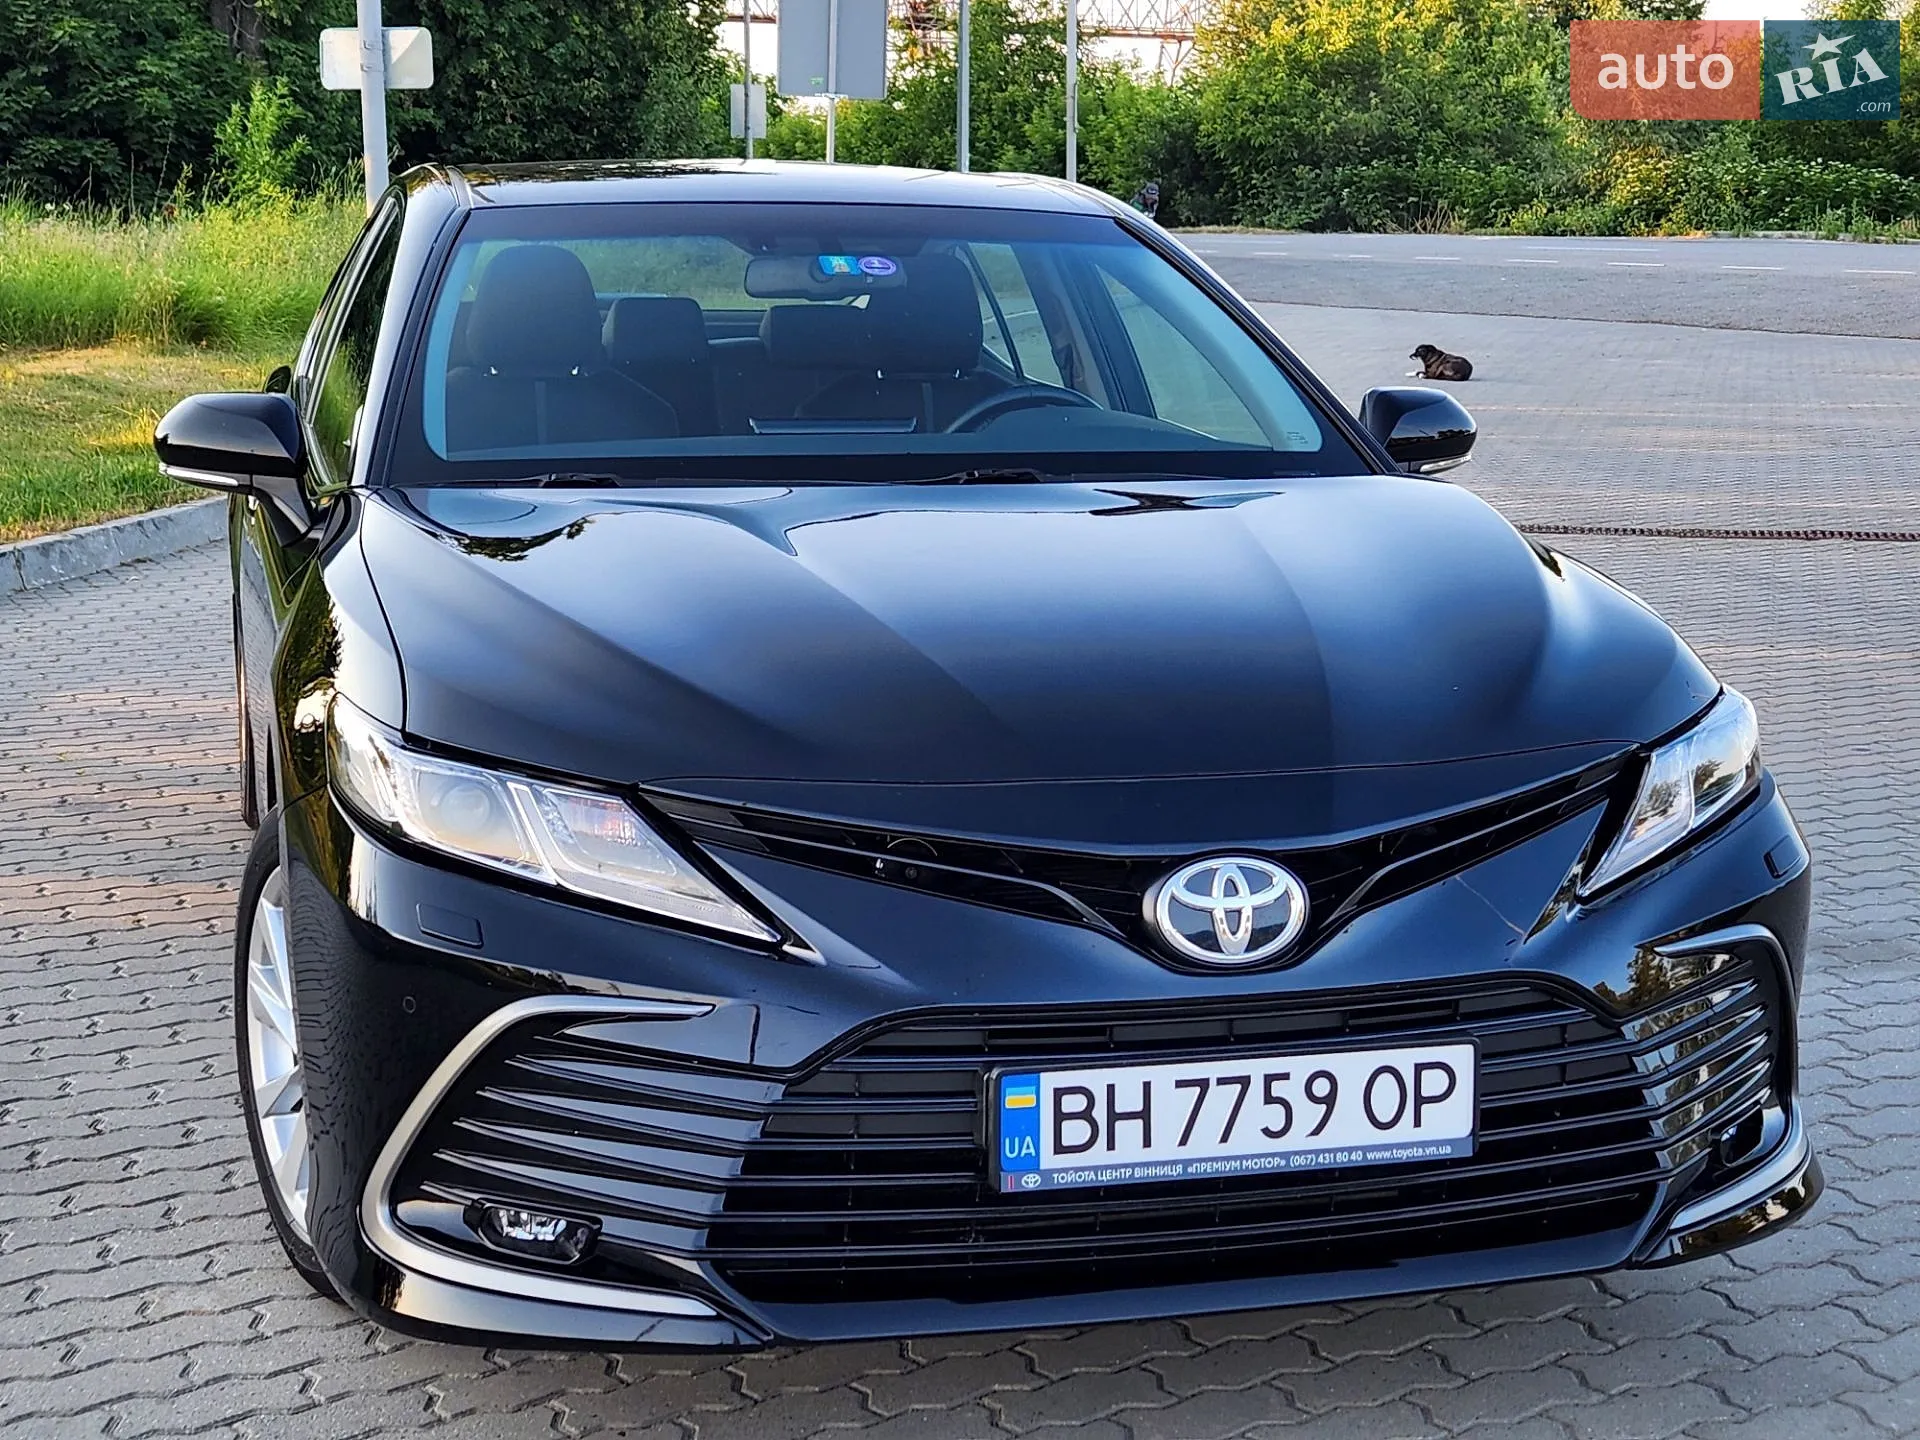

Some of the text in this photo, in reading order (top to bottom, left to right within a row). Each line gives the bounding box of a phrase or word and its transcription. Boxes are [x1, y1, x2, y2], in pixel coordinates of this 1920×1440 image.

[1052, 1060, 1457, 1156] BH 7759 OP
[1005, 1136, 1037, 1159] UA
[1052, 1145, 1452, 1185] ТОЙОТА ЦЕНТР ВІННИЦЯ «ПРЕМІУМ МОТОР» (067) 431 80 40 www.toyota.vn.ua
